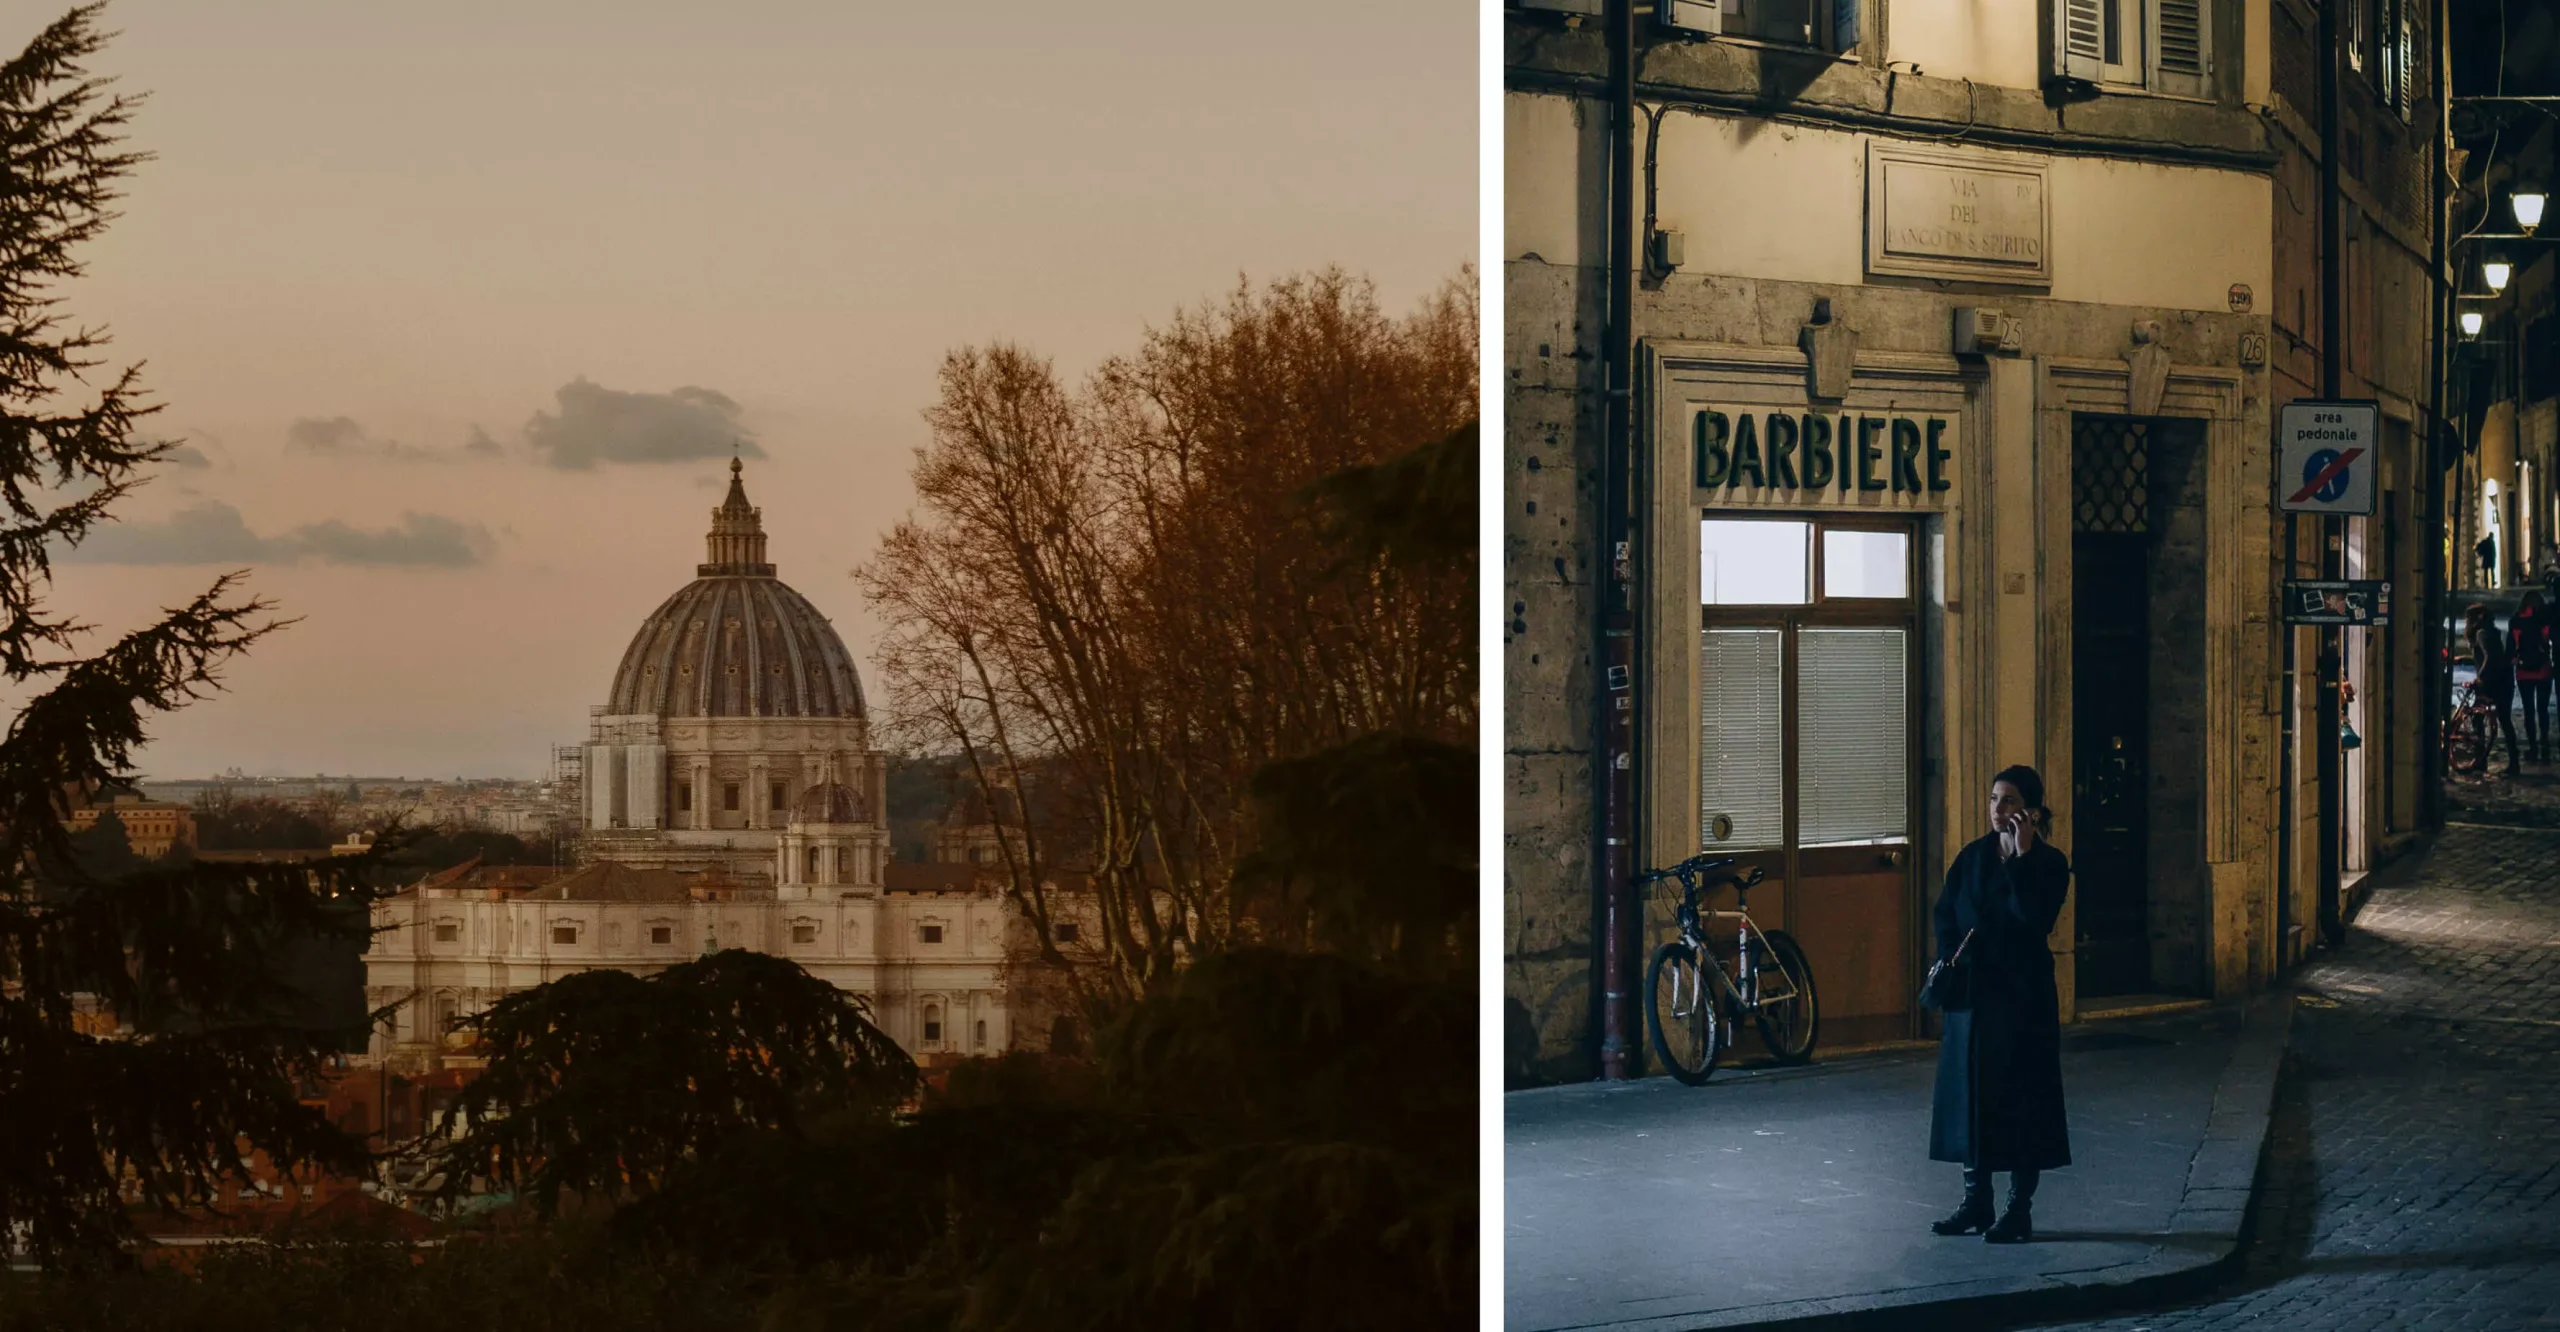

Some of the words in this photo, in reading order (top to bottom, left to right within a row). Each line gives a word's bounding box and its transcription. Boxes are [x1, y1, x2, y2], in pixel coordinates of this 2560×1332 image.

[1951, 177, 1979, 198] VIA
[1951, 205, 1979, 224] DEL
[1982, 234, 2038, 256] SPIRITO
[2002, 319, 2021, 346] 25
[2243, 336, 2264, 361] 26
[2314, 412, 2342, 424] area
[2297, 427, 2358, 442] pedonale
[1696, 410, 1951, 494] BARBIERE
